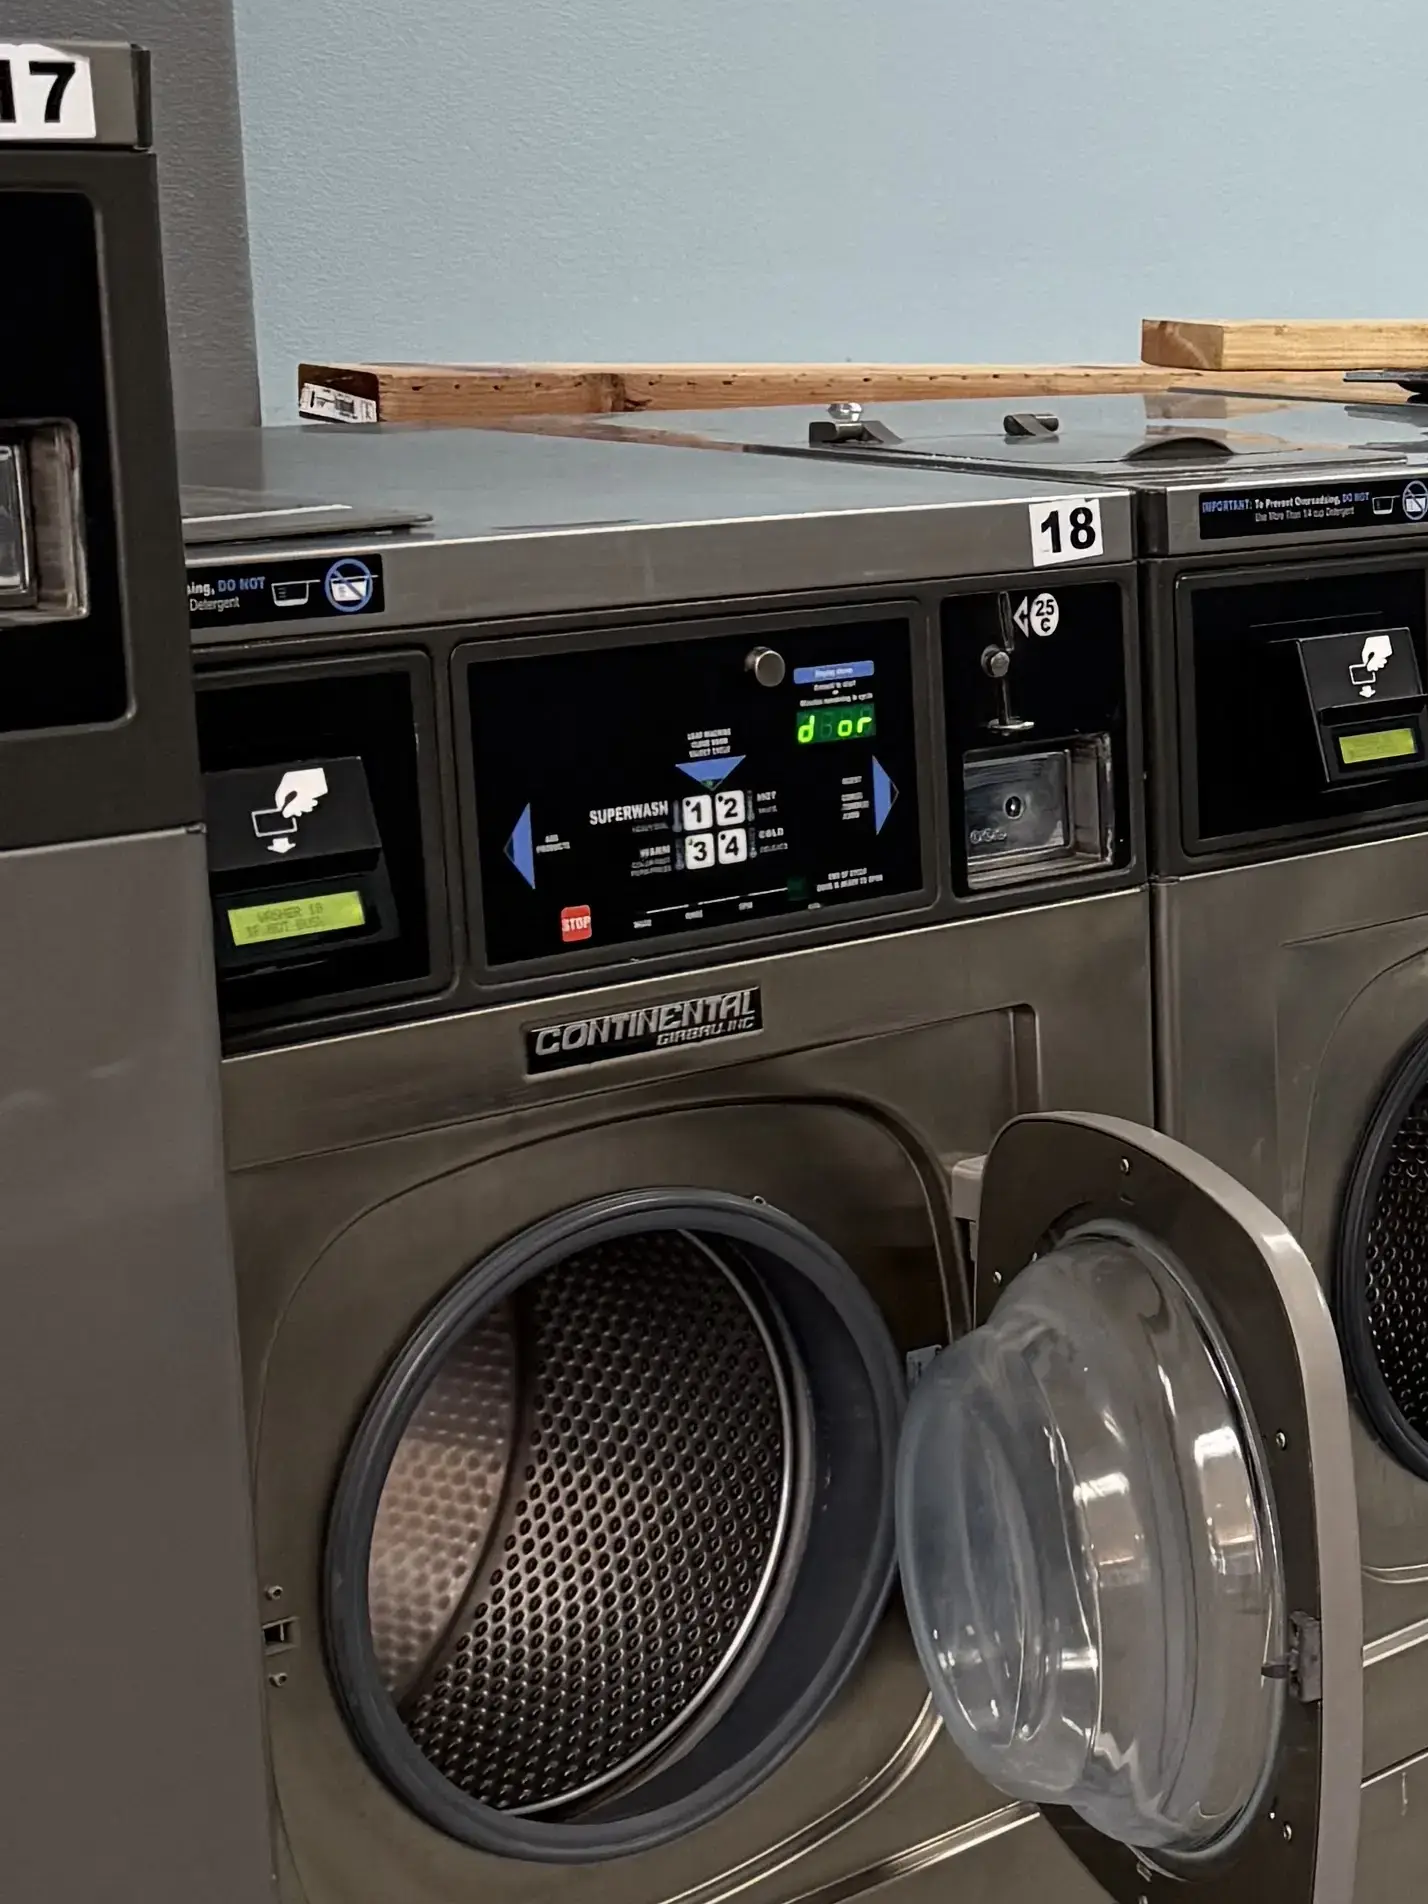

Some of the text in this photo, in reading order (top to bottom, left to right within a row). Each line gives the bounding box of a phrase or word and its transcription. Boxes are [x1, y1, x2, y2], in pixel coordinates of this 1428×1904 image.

[1040, 506, 1096, 553] 18
[217, 579, 236, 592] DO
[239, 576, 266, 591] NOT
[189, 596, 240, 612] Detergent
[1035, 599, 1055, 617] 25
[797, 714, 873, 743] dor
[589, 800, 669, 825] SUPERWASH
[691, 802, 702, 824] 1
[724, 797, 738, 818] 2
[693, 841, 707, 861] 3
[725, 835, 739, 856] 4
[758, 827, 784, 839] COLD
[562, 916, 591, 932] STOP
[535, 990, 755, 1056] CONTINENTAL
